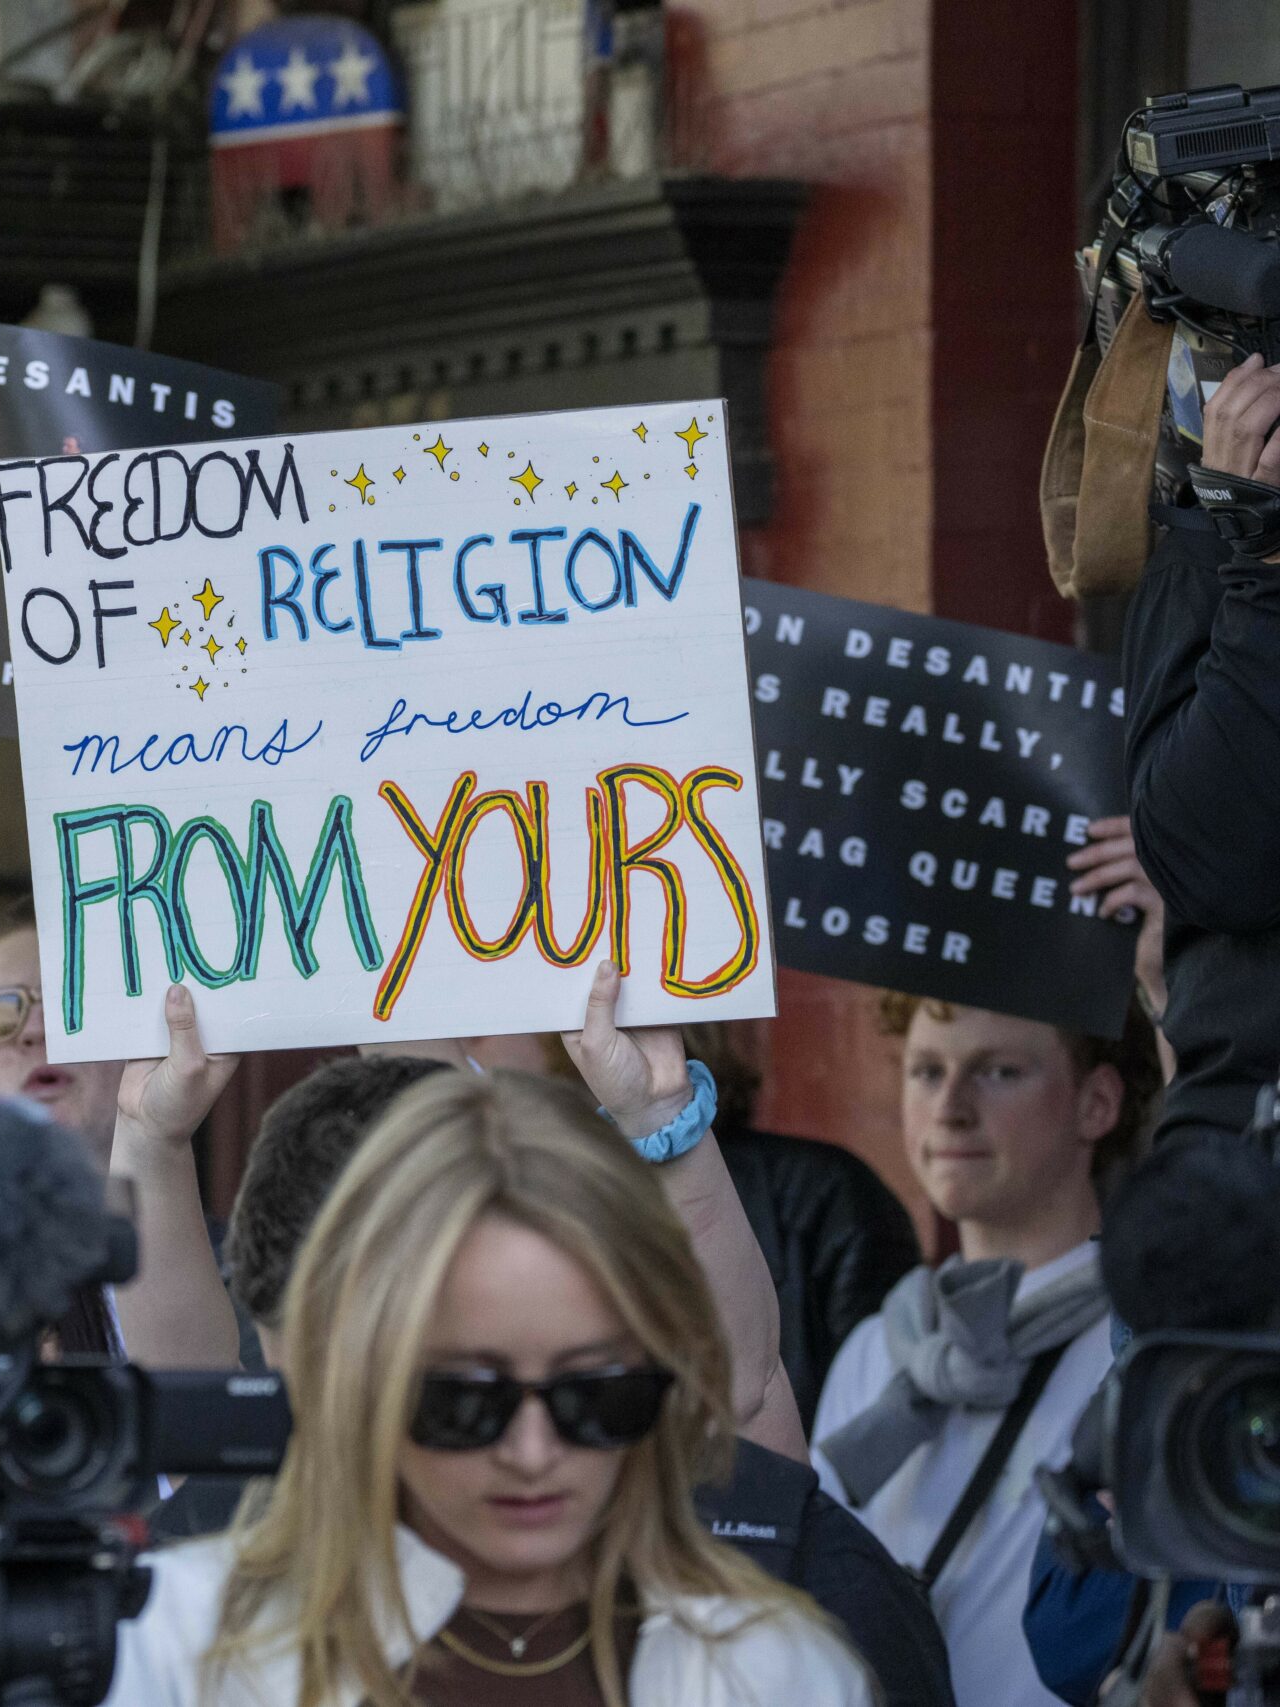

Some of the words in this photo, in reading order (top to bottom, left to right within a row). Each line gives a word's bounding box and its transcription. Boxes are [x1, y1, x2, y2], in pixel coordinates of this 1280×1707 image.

[20, 579, 137, 669] OF
[258, 503, 703, 651] RELIGION
[844, 628, 1125, 718] DESANTIS
[63, 719, 322, 775] means
[360, 691, 690, 762] freedom
[820, 686, 1064, 771] REALLY,
[763, 749, 865, 796] LLY
[900, 778, 1091, 846] SCARE
[762, 817, 868, 868] RAG
[53, 795, 385, 1035] FROM
[373, 763, 760, 1022] YOURS
[785, 898, 971, 963] LOSER
